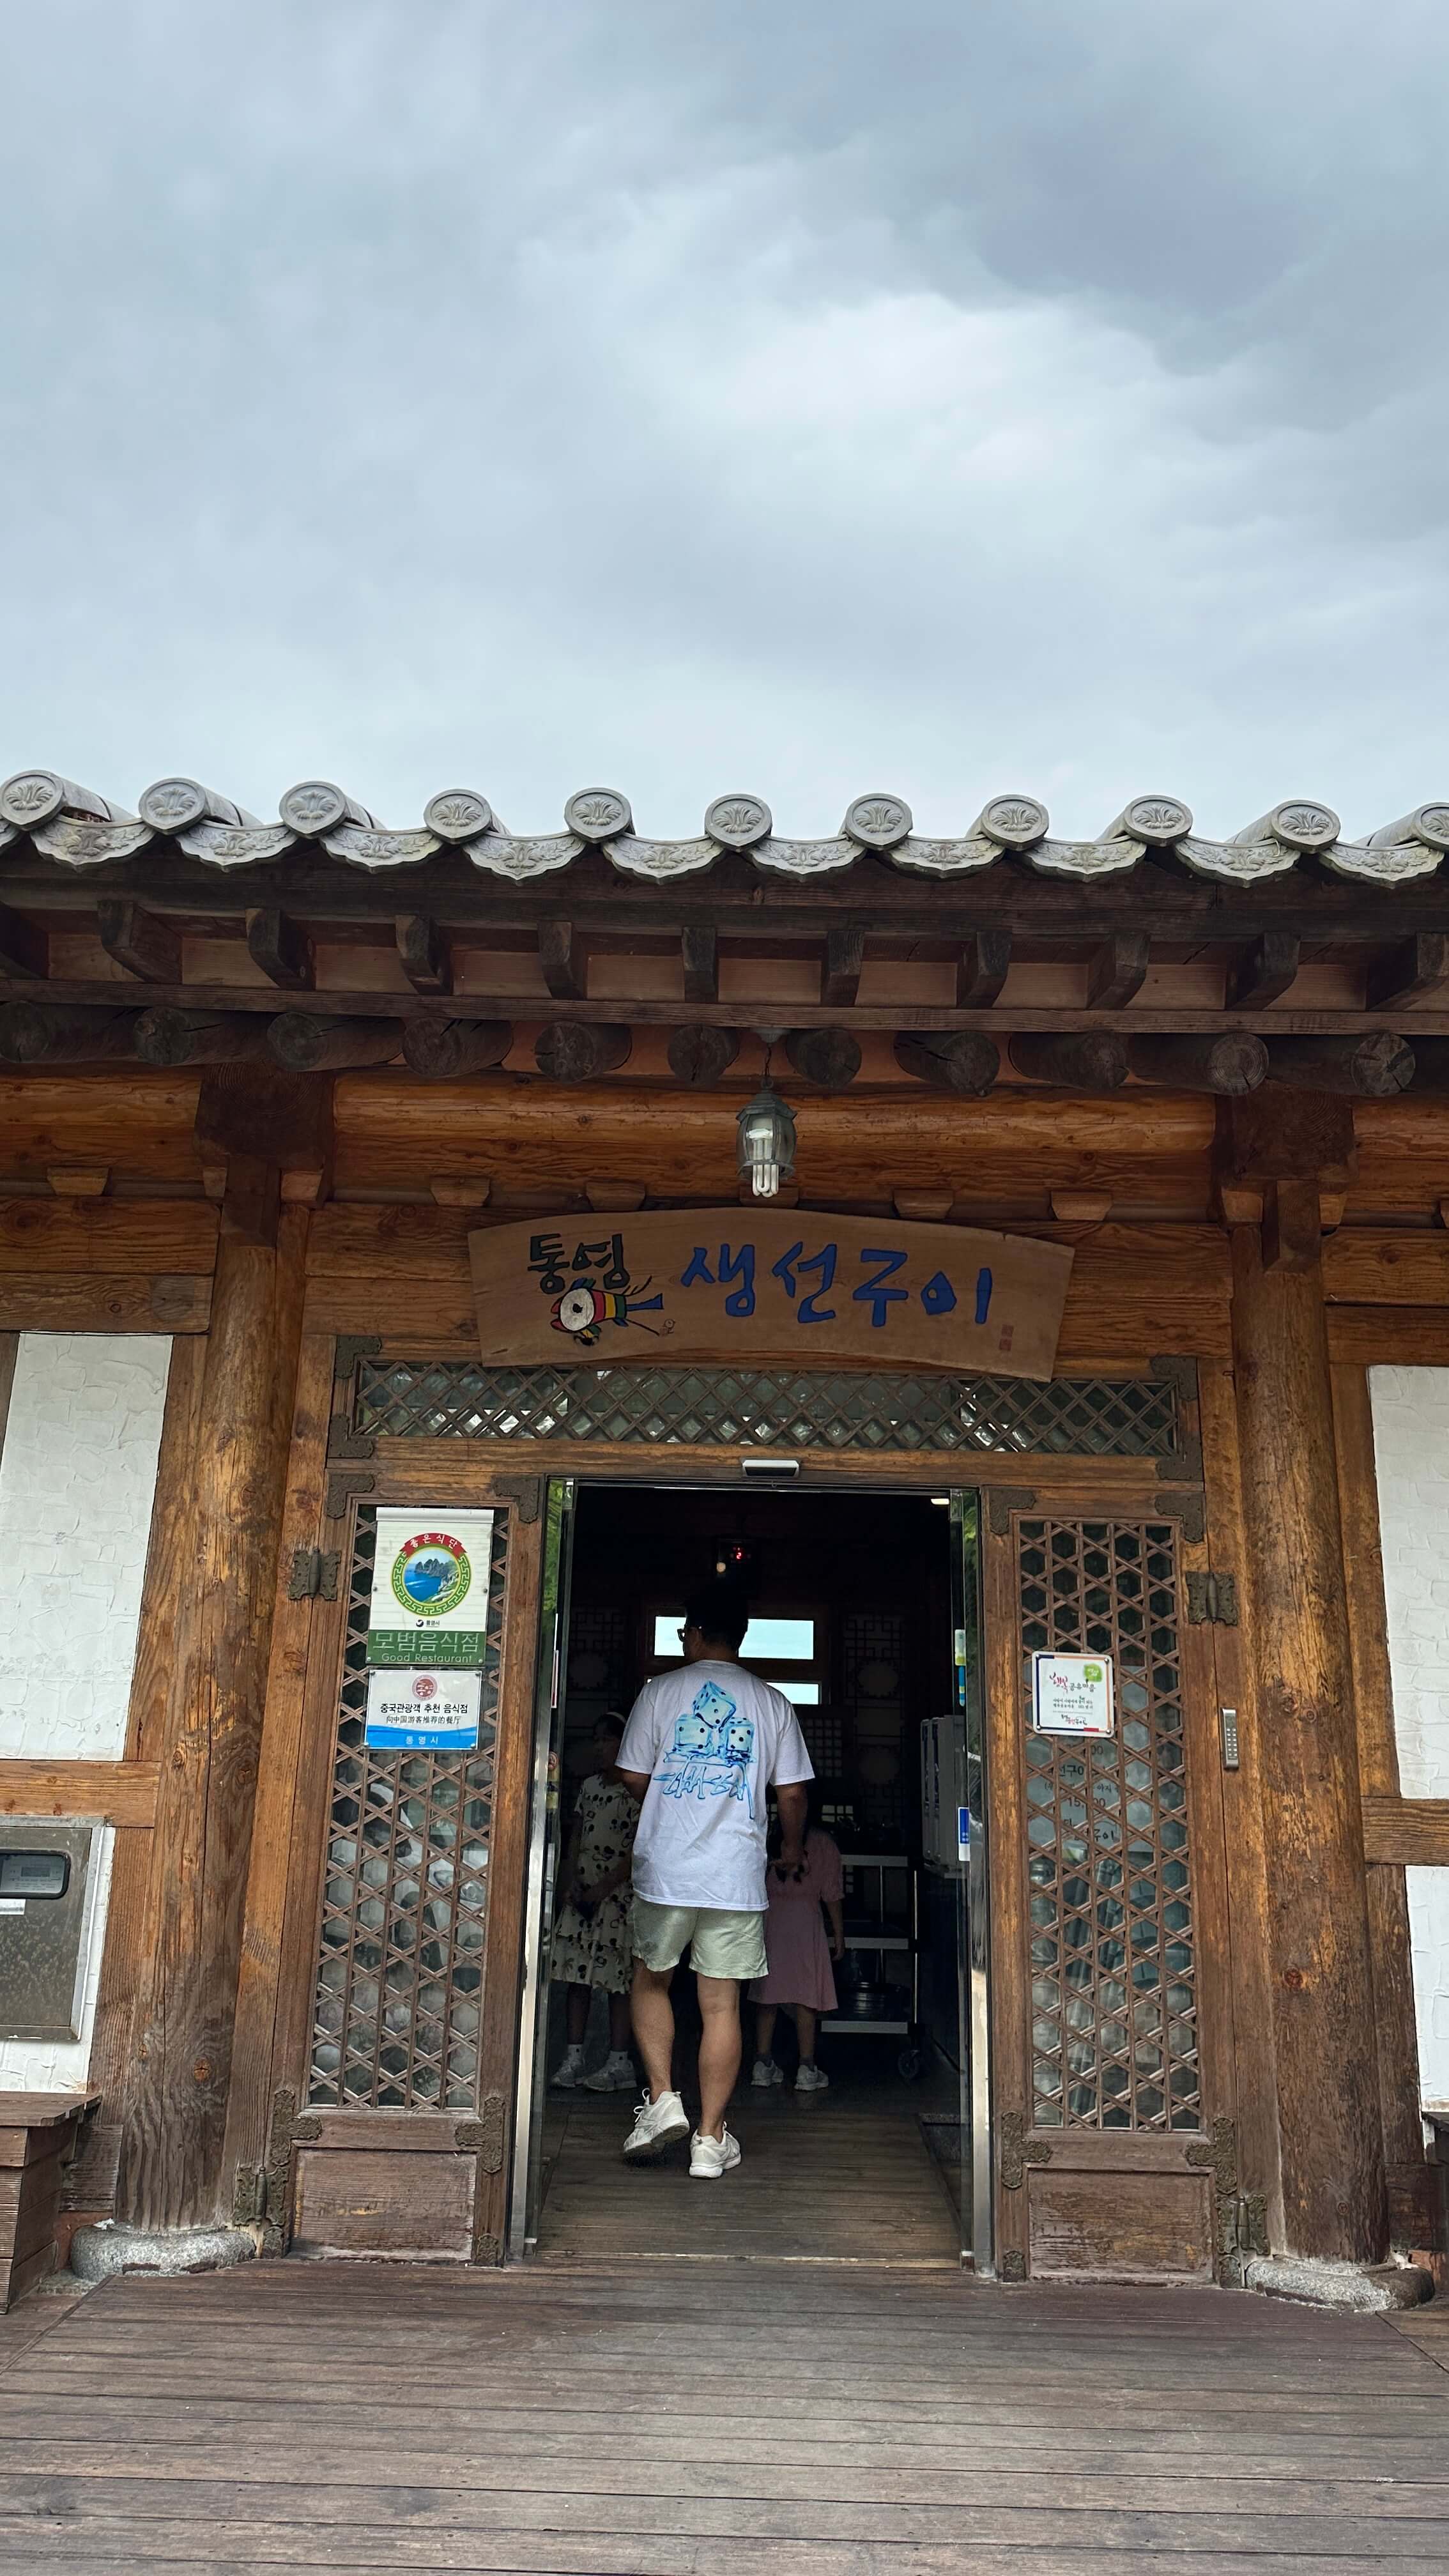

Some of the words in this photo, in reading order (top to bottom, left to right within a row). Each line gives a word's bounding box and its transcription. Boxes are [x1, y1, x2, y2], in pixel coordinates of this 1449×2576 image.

[527, 1233, 631, 1295] 통영
[680, 1241, 993, 1328] 생선구이
[372, 1632, 479, 1652] 모범음식점
[381, 1653, 410, 1662] Good
[415, 1653, 471, 1664] Restaurant
[380, 1703, 420, 1713] 중국관광객
[424, 1703, 440, 1713] 추천
[443, 1703, 468, 1713] 음식점
